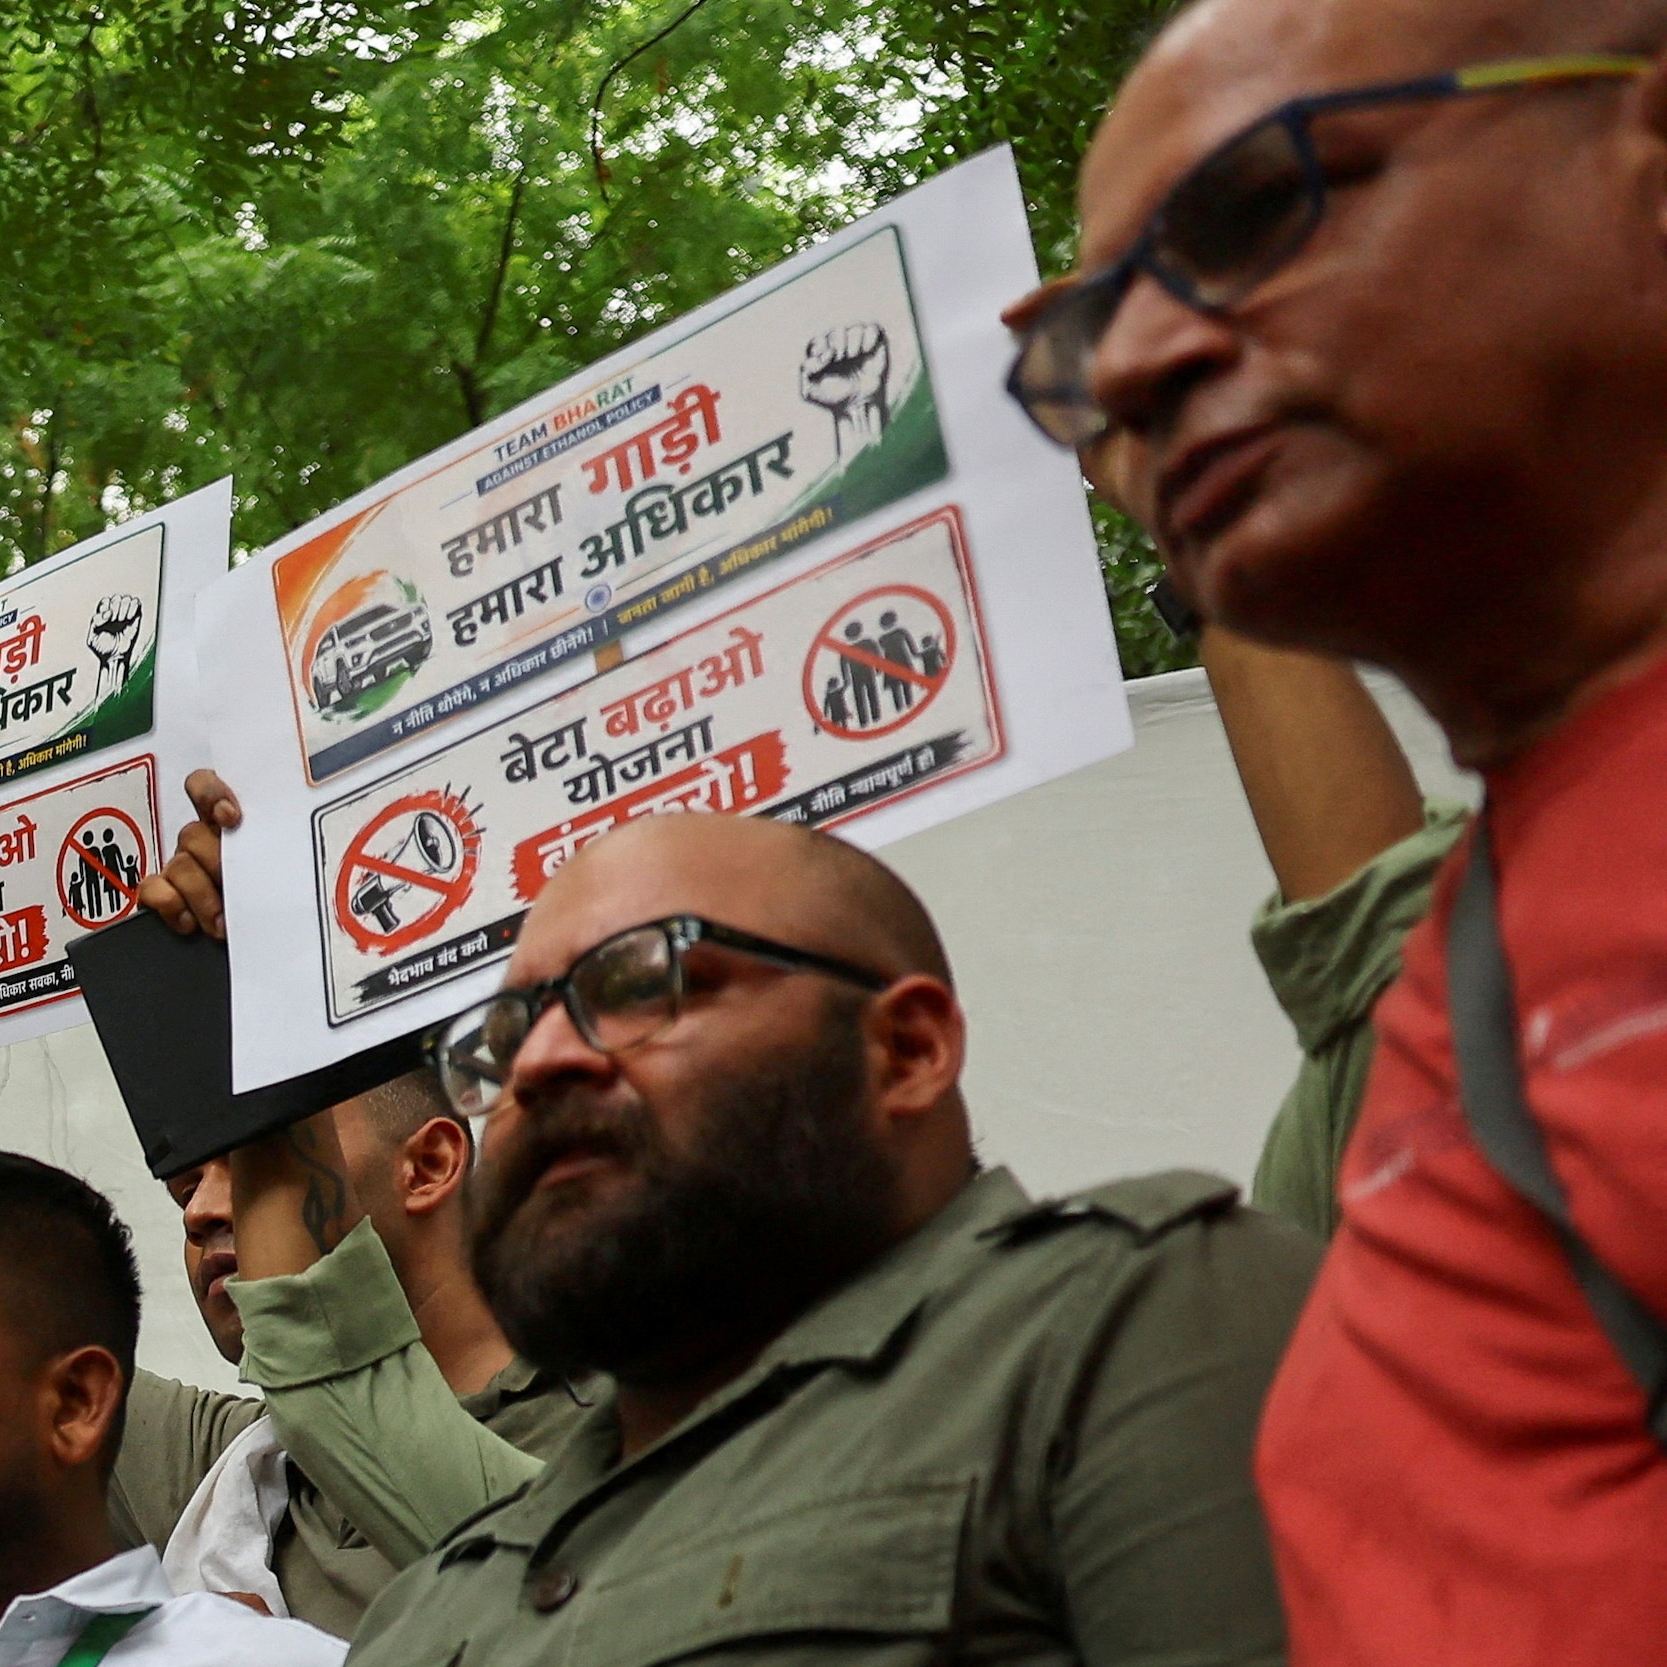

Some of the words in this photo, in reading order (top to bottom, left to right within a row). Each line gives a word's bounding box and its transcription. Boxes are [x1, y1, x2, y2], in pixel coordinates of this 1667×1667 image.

[492, 421, 548, 462] TEAM
[552, 375, 634, 432] BHARAT
[440, 482, 562, 577] हमारा
[445, 554, 563, 646] हमारा
[577, 430, 795, 578] अधिकार
[499, 716, 586, 783] बेटा
[600, 627, 762, 736] बढ़ाओ
[562, 714, 713, 804] योजना
